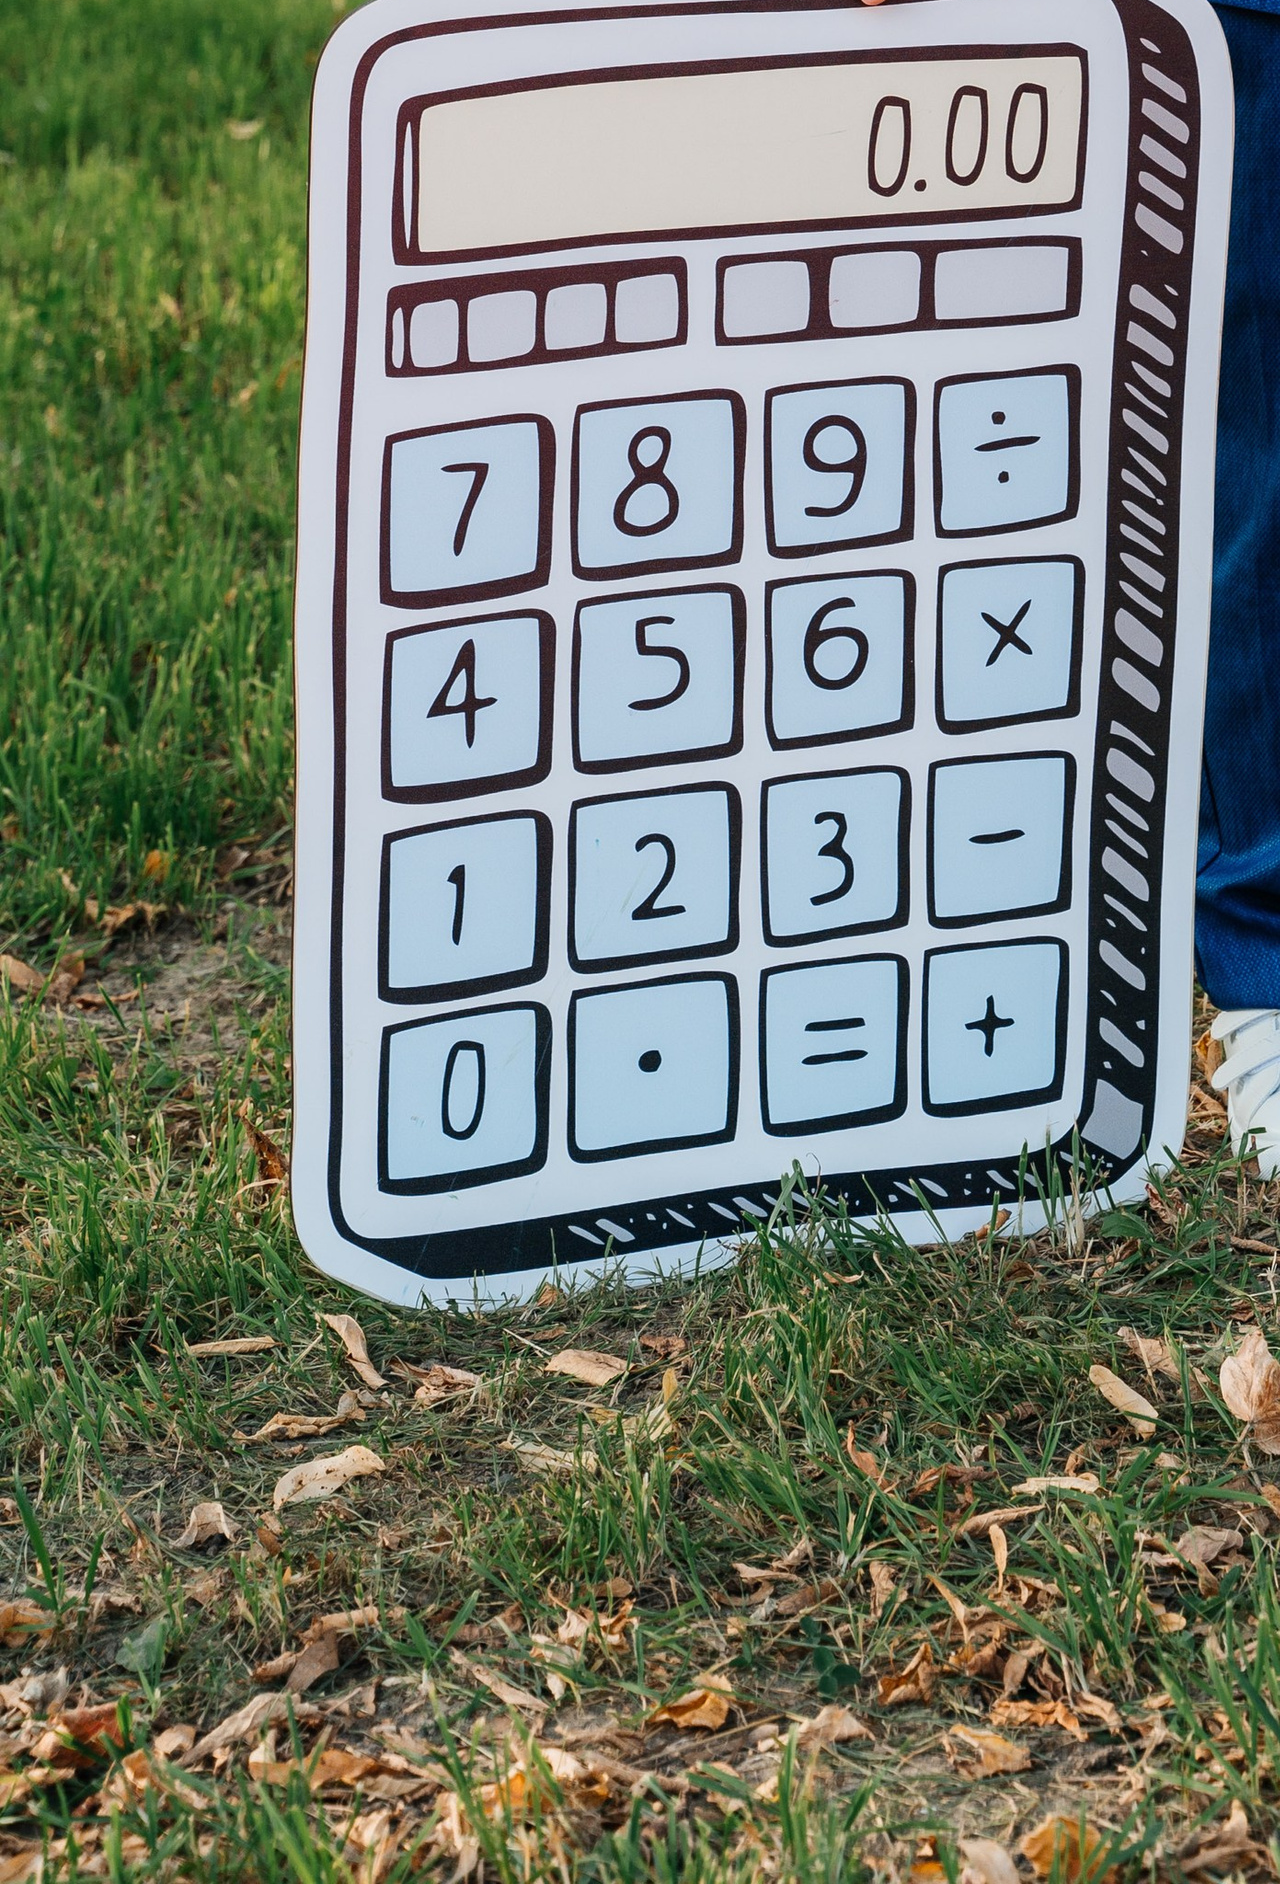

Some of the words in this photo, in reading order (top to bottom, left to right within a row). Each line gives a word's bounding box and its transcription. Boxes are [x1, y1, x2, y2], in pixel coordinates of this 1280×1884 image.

[866, 81, 1050, 199] 0.00
[439, 461, 491, 558] 7
[611, 424, 681, 539] 8
[801, 413, 869, 519] 9
[425, 637, 499, 750] 4
[626, 614, 692, 712] 5
[802, 595, 870, 692] 6
[445, 863, 467, 947] 1
[630, 831, 688, 922] 2
[808, 810, 856, 908] 3
[440, 1039, 487, 1142] 0
